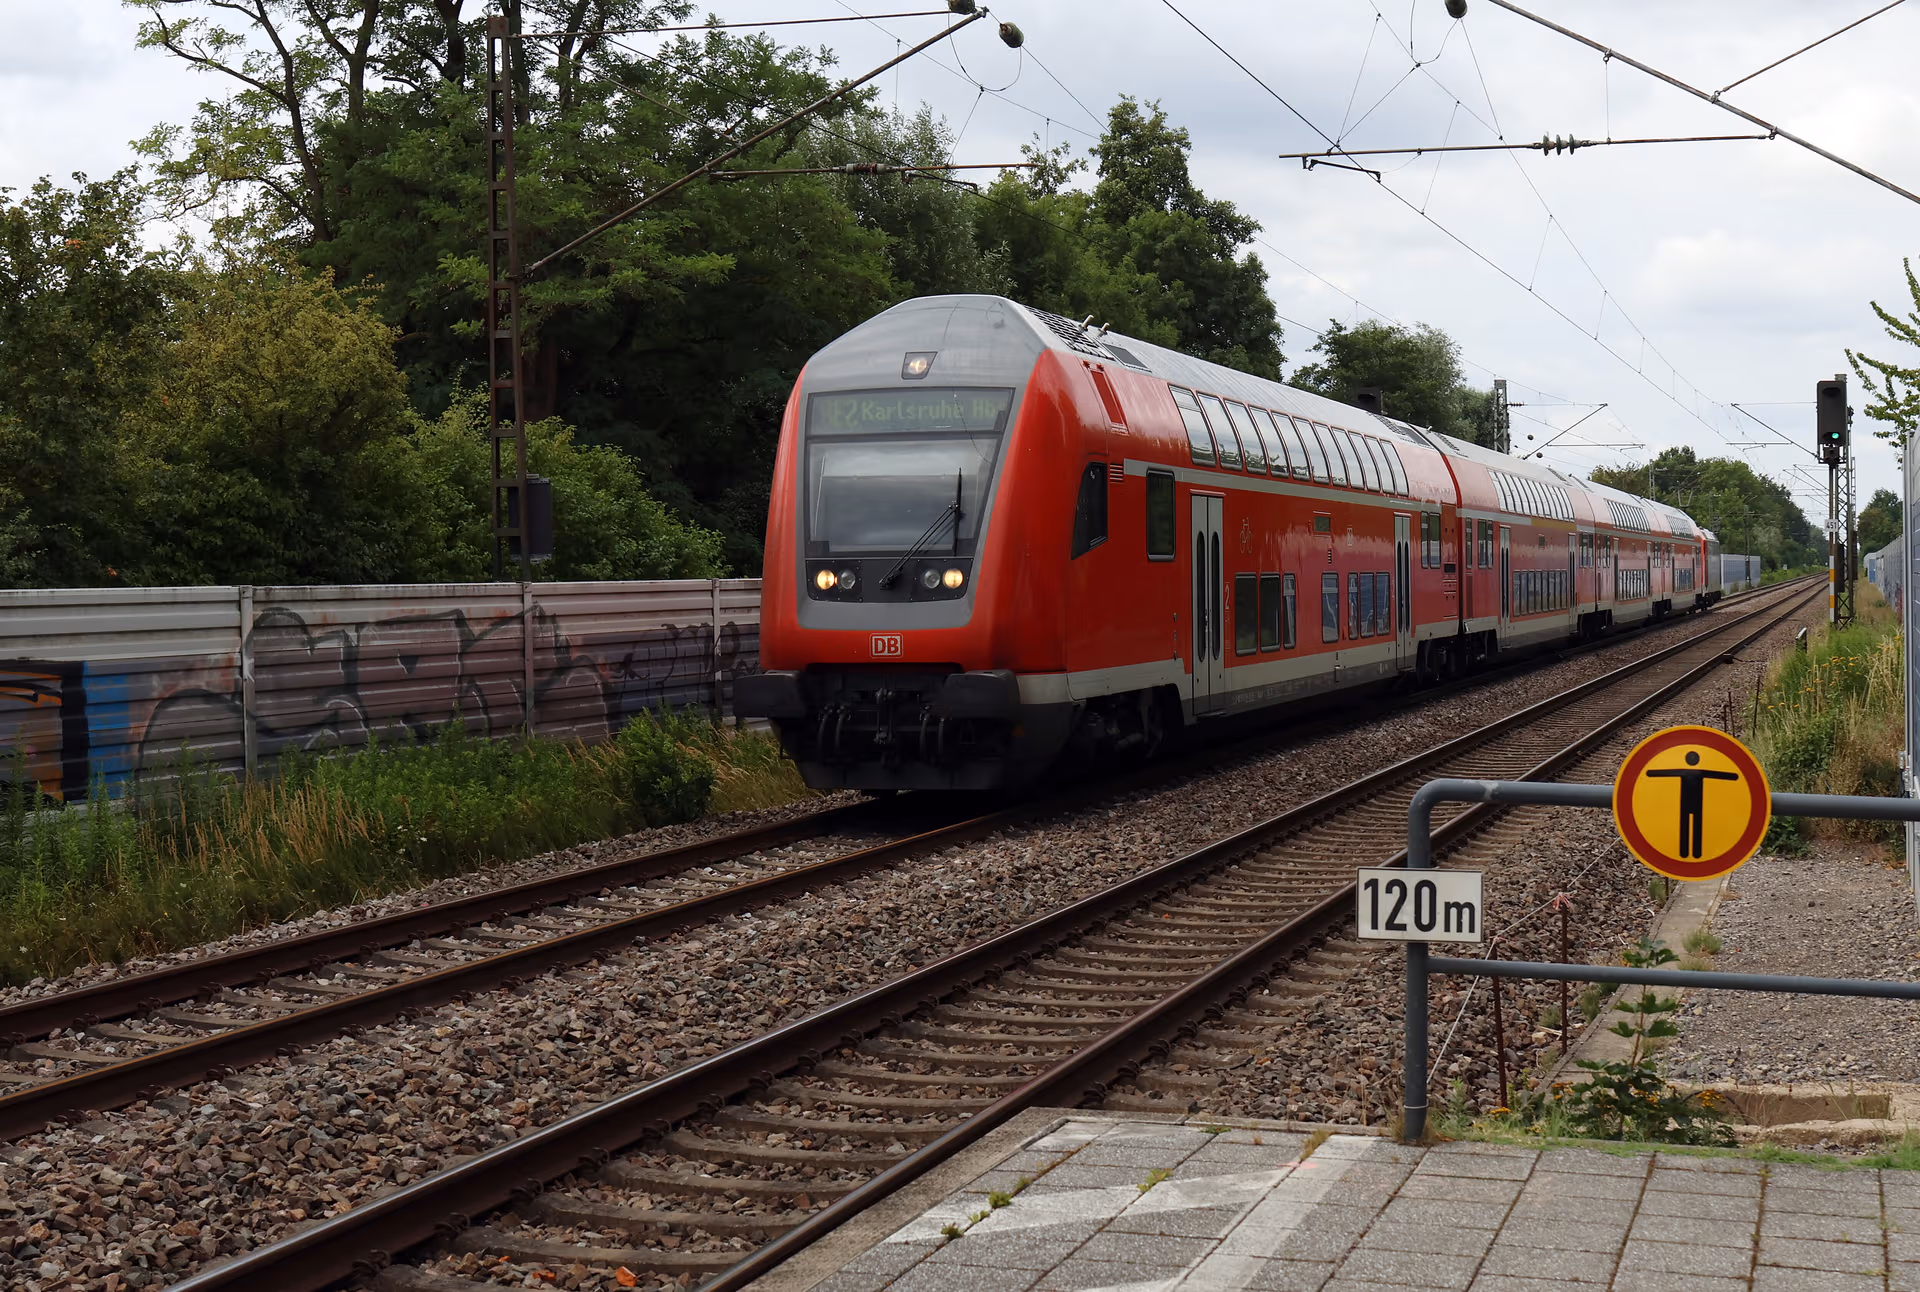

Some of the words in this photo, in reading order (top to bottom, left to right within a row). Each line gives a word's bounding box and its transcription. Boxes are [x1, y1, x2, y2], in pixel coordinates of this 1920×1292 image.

[861, 398, 963, 421] Karlsruhe
[973, 398, 1003, 418] Hb
[1225, 584, 1230, 610] 2
[872, 636, 900, 655] DB
